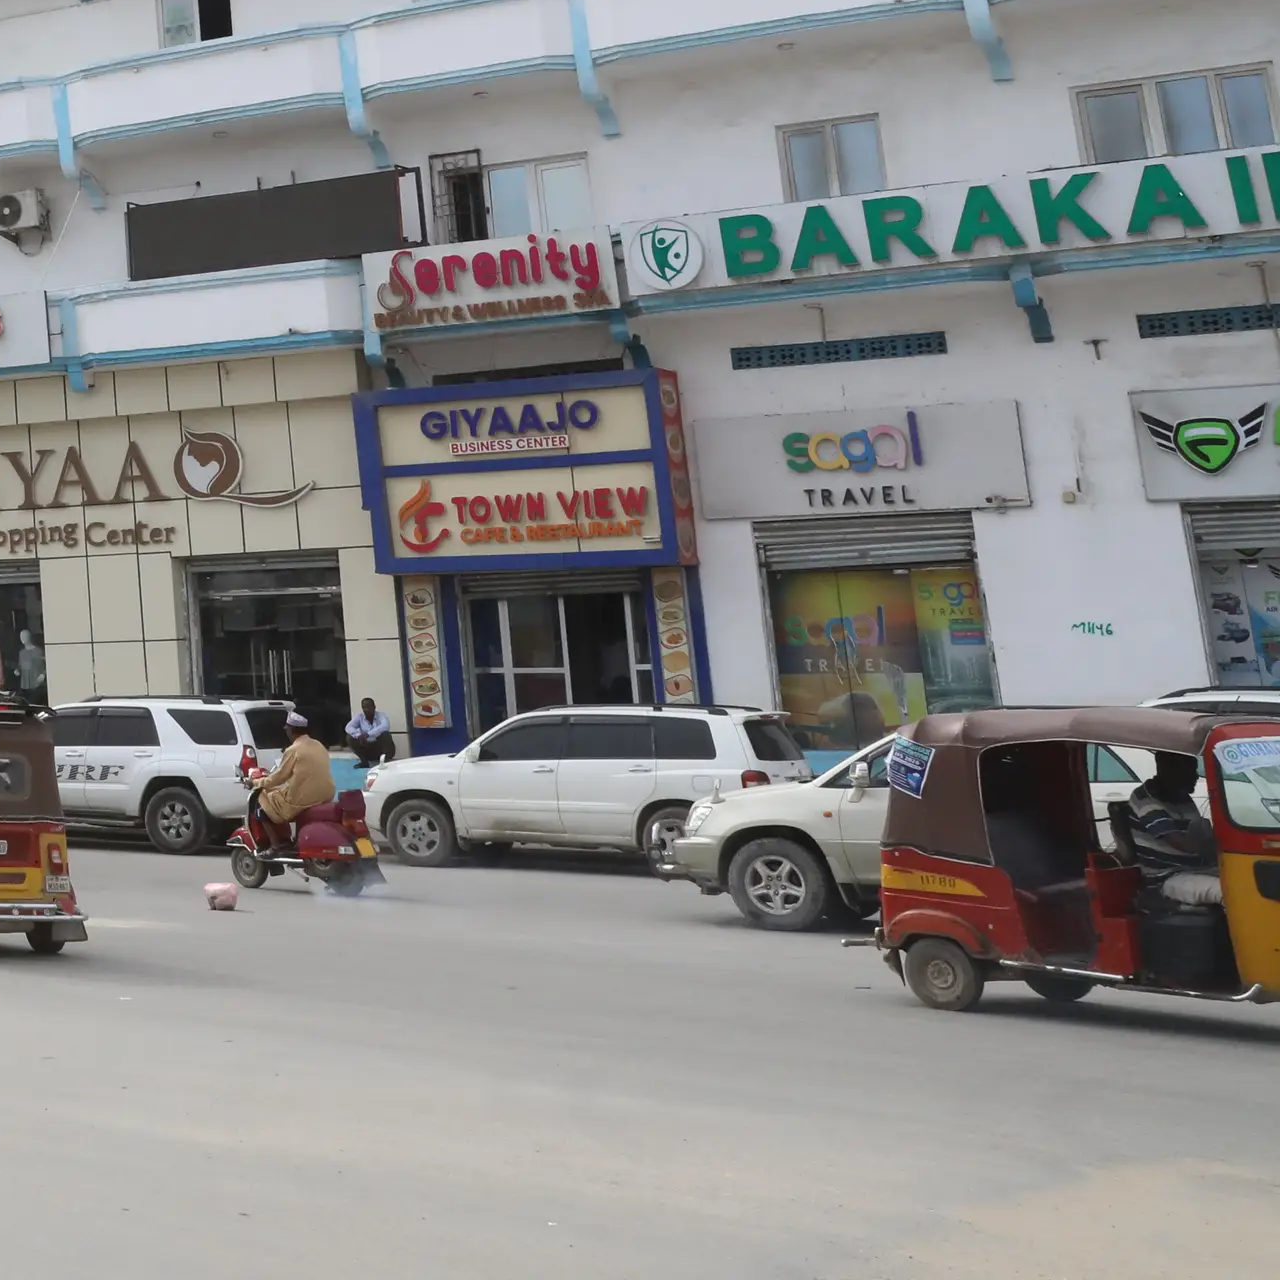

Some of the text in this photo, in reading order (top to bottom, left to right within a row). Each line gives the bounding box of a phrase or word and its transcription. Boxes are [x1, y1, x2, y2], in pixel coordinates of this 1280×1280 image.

[378, 233, 601, 308] Serenity
[420, 400, 600, 440] GIYAAJO
[451, 436, 567, 453] BUSINESS CENTER
[451, 486, 647, 524] TOWN VIEW
[804, 484, 915, 507] TRAVEL
[86, 520, 176, 548] Center
[460, 520, 644, 544] CAFE & RESTAURANT
